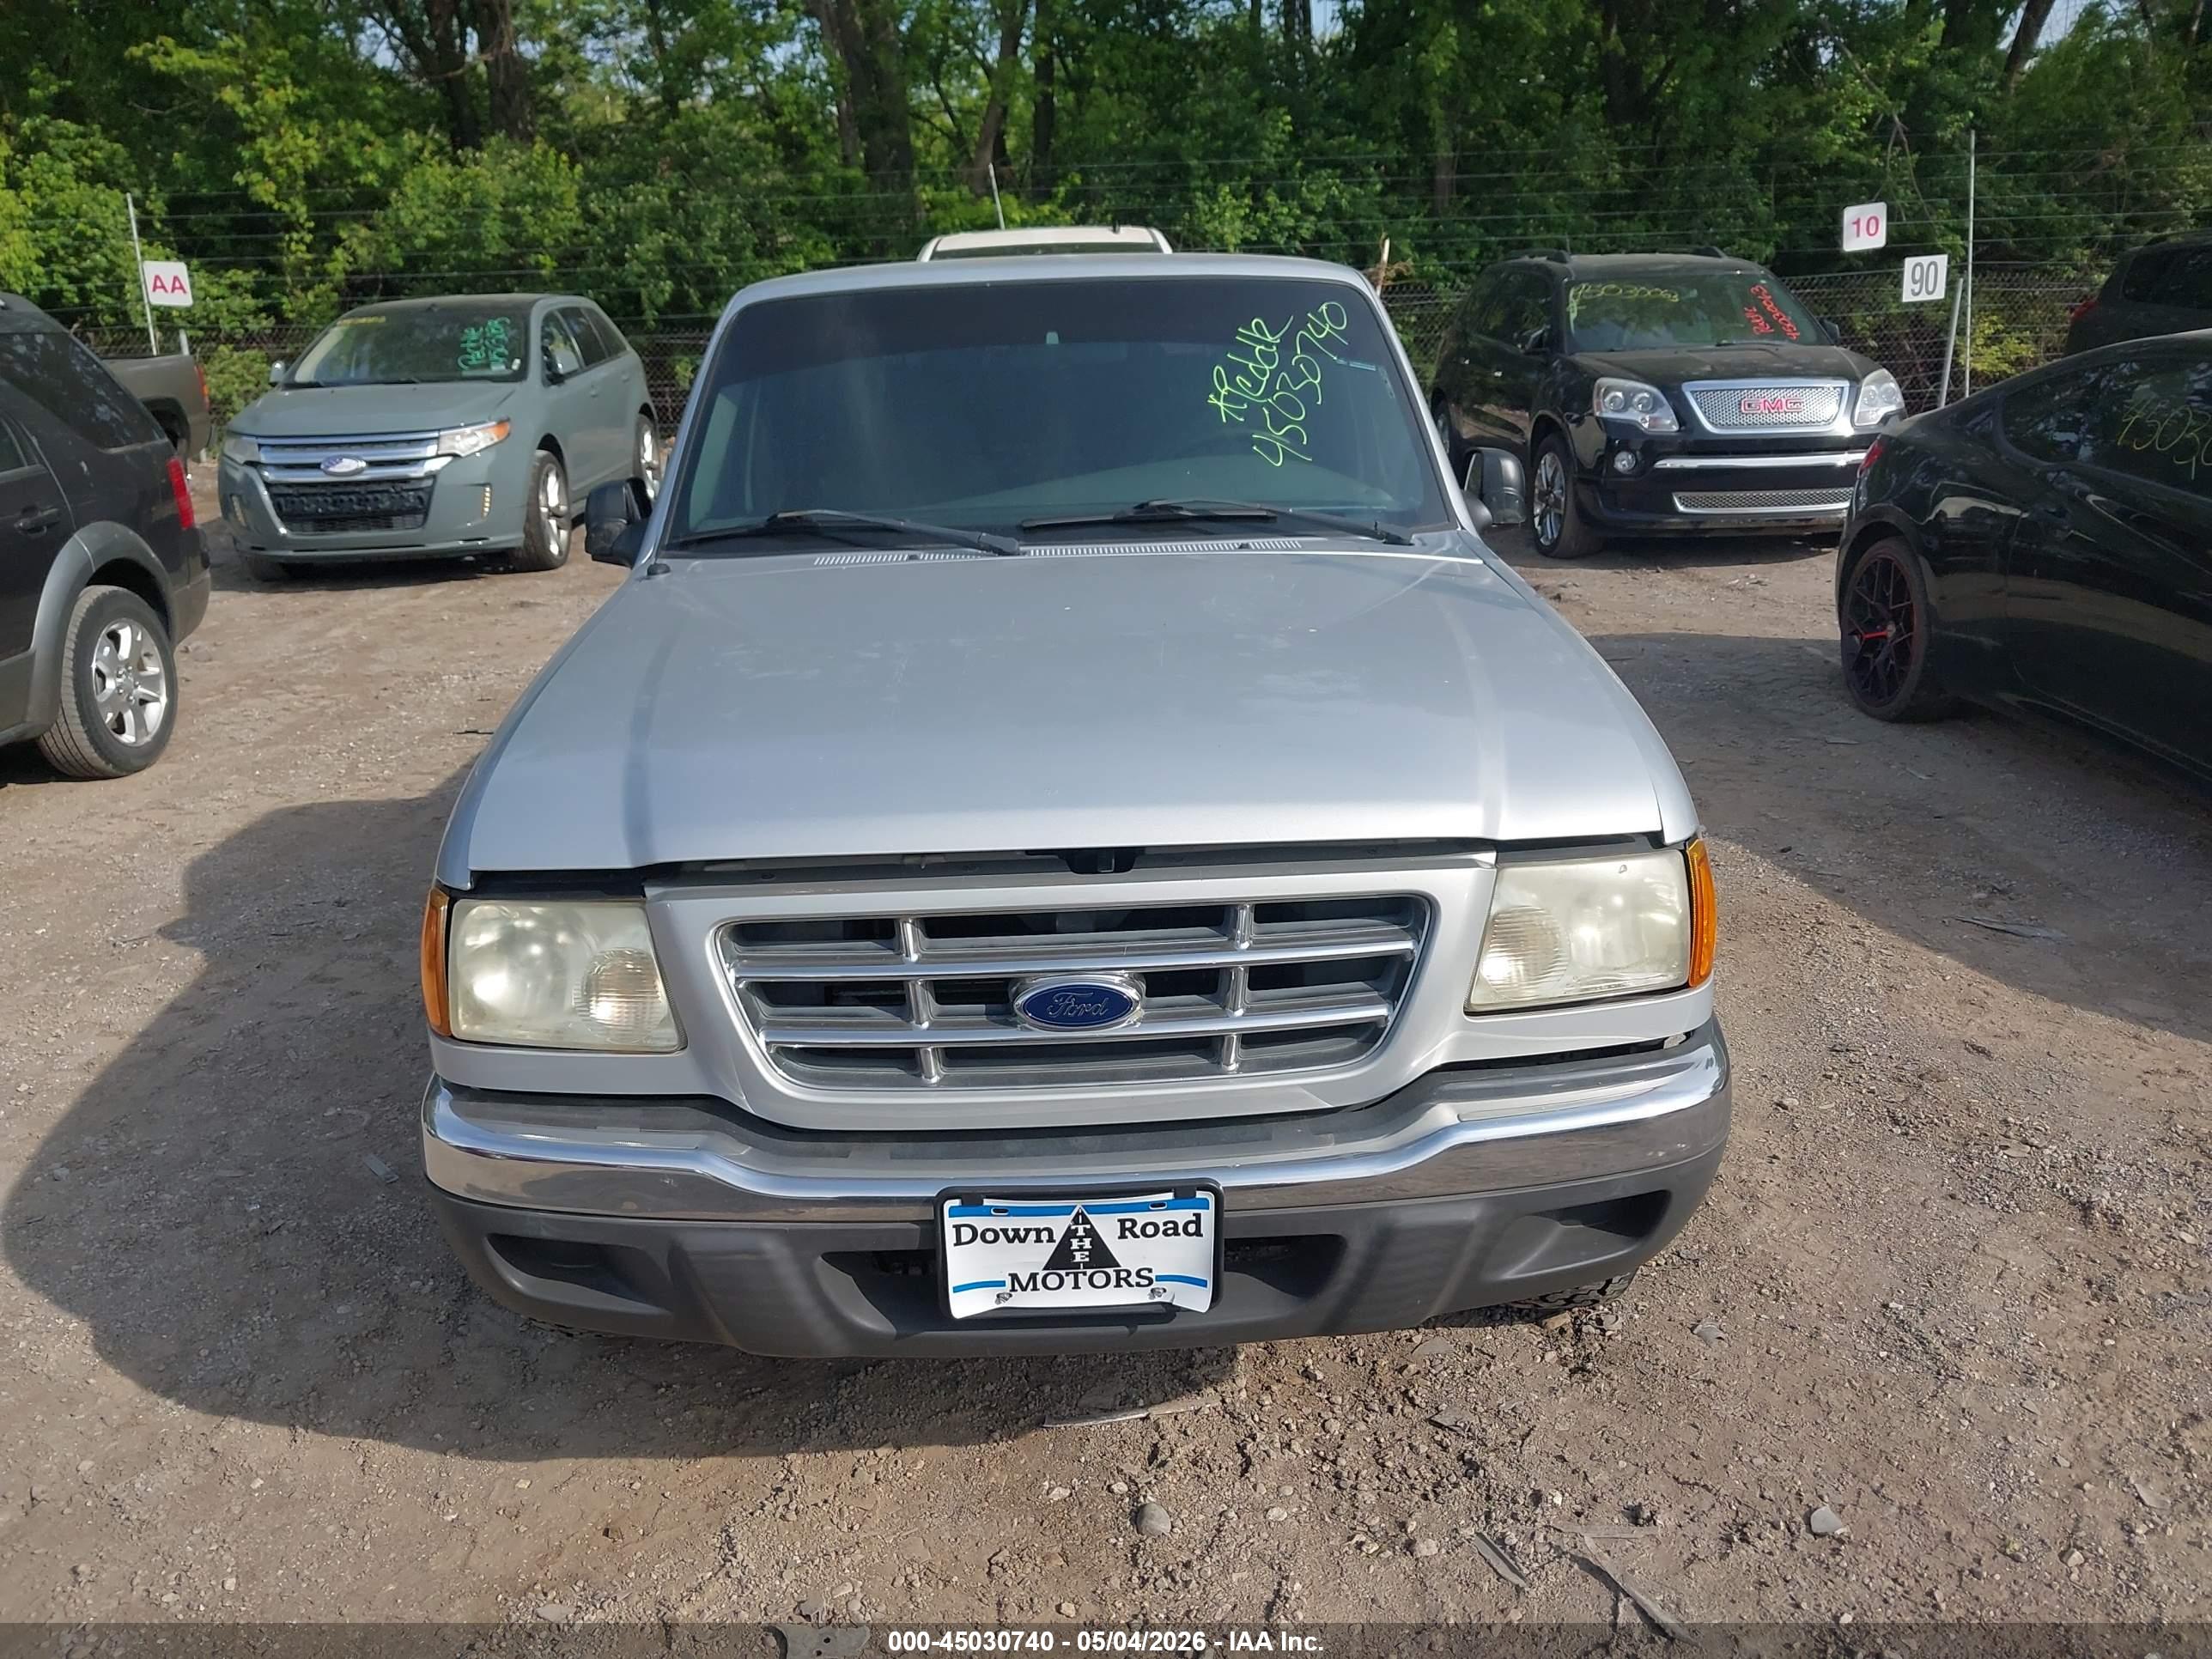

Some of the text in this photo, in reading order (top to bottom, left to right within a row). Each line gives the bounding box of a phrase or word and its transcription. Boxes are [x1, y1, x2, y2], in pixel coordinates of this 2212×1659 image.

[1851, 215, 1880, 238] 10
[152, 274, 187, 294] AA
[1910, 260, 1939, 297] 90
[1251, 301, 1349, 467] 45030740
[1741, 398, 1804, 414] GMC
[1047, 991, 1109, 1018] Ford
[951, 1212, 1204, 1262] Down THE Road
[1007, 1267, 1155, 1293] MOTORS
